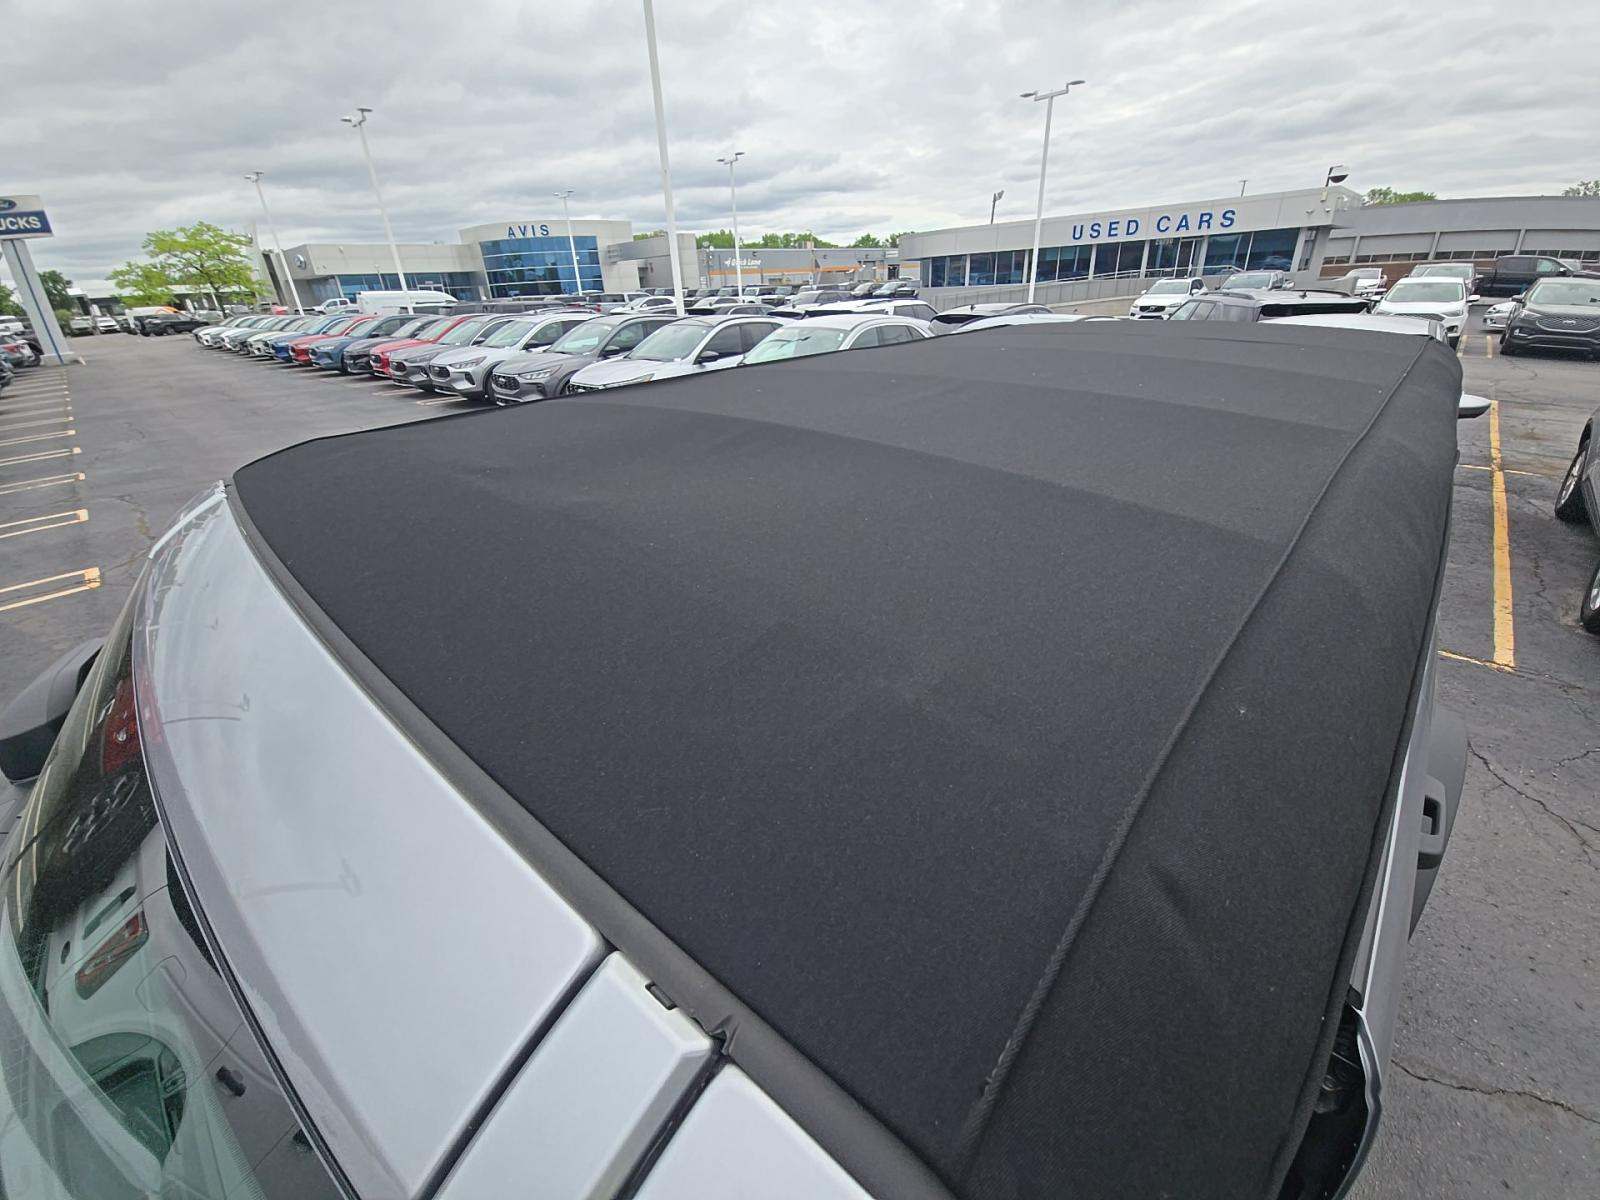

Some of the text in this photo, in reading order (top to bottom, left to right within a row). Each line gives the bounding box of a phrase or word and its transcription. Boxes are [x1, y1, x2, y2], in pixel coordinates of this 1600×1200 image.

[508, 224, 549, 238] AVIS
[1072, 209, 1236, 240] USED CARS
